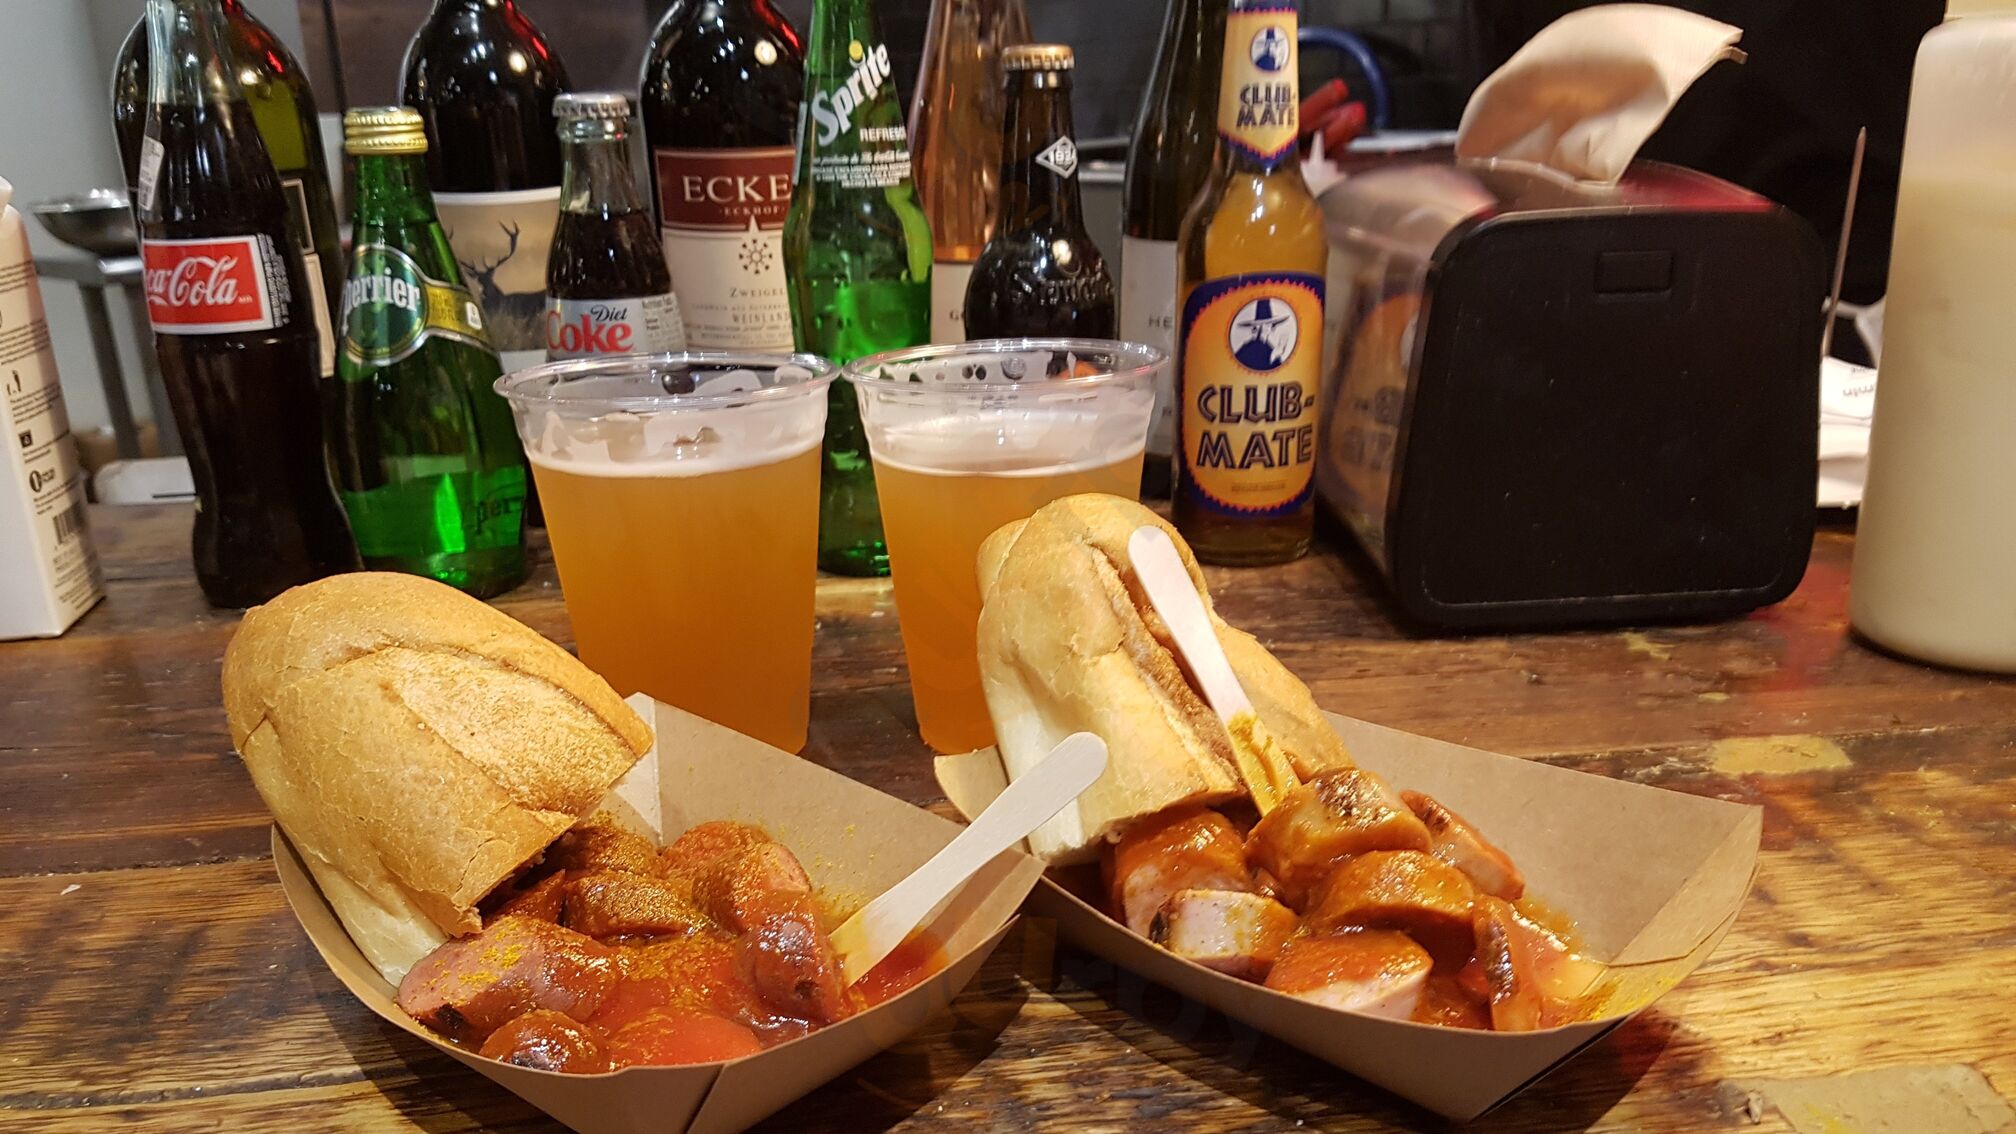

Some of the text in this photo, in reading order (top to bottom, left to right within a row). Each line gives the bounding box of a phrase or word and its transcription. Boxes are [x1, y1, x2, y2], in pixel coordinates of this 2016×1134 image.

[812, 41, 891, 147] Sprite
[1236, 105, 1295, 128] MATE
[682, 174, 792, 203] ECKE
[547, 309, 634, 353] Coke
[590, 304, 628, 322] Diet
[1197, 381, 1316, 424] CLUB-
[1196, 423, 1313, 470] MATE
